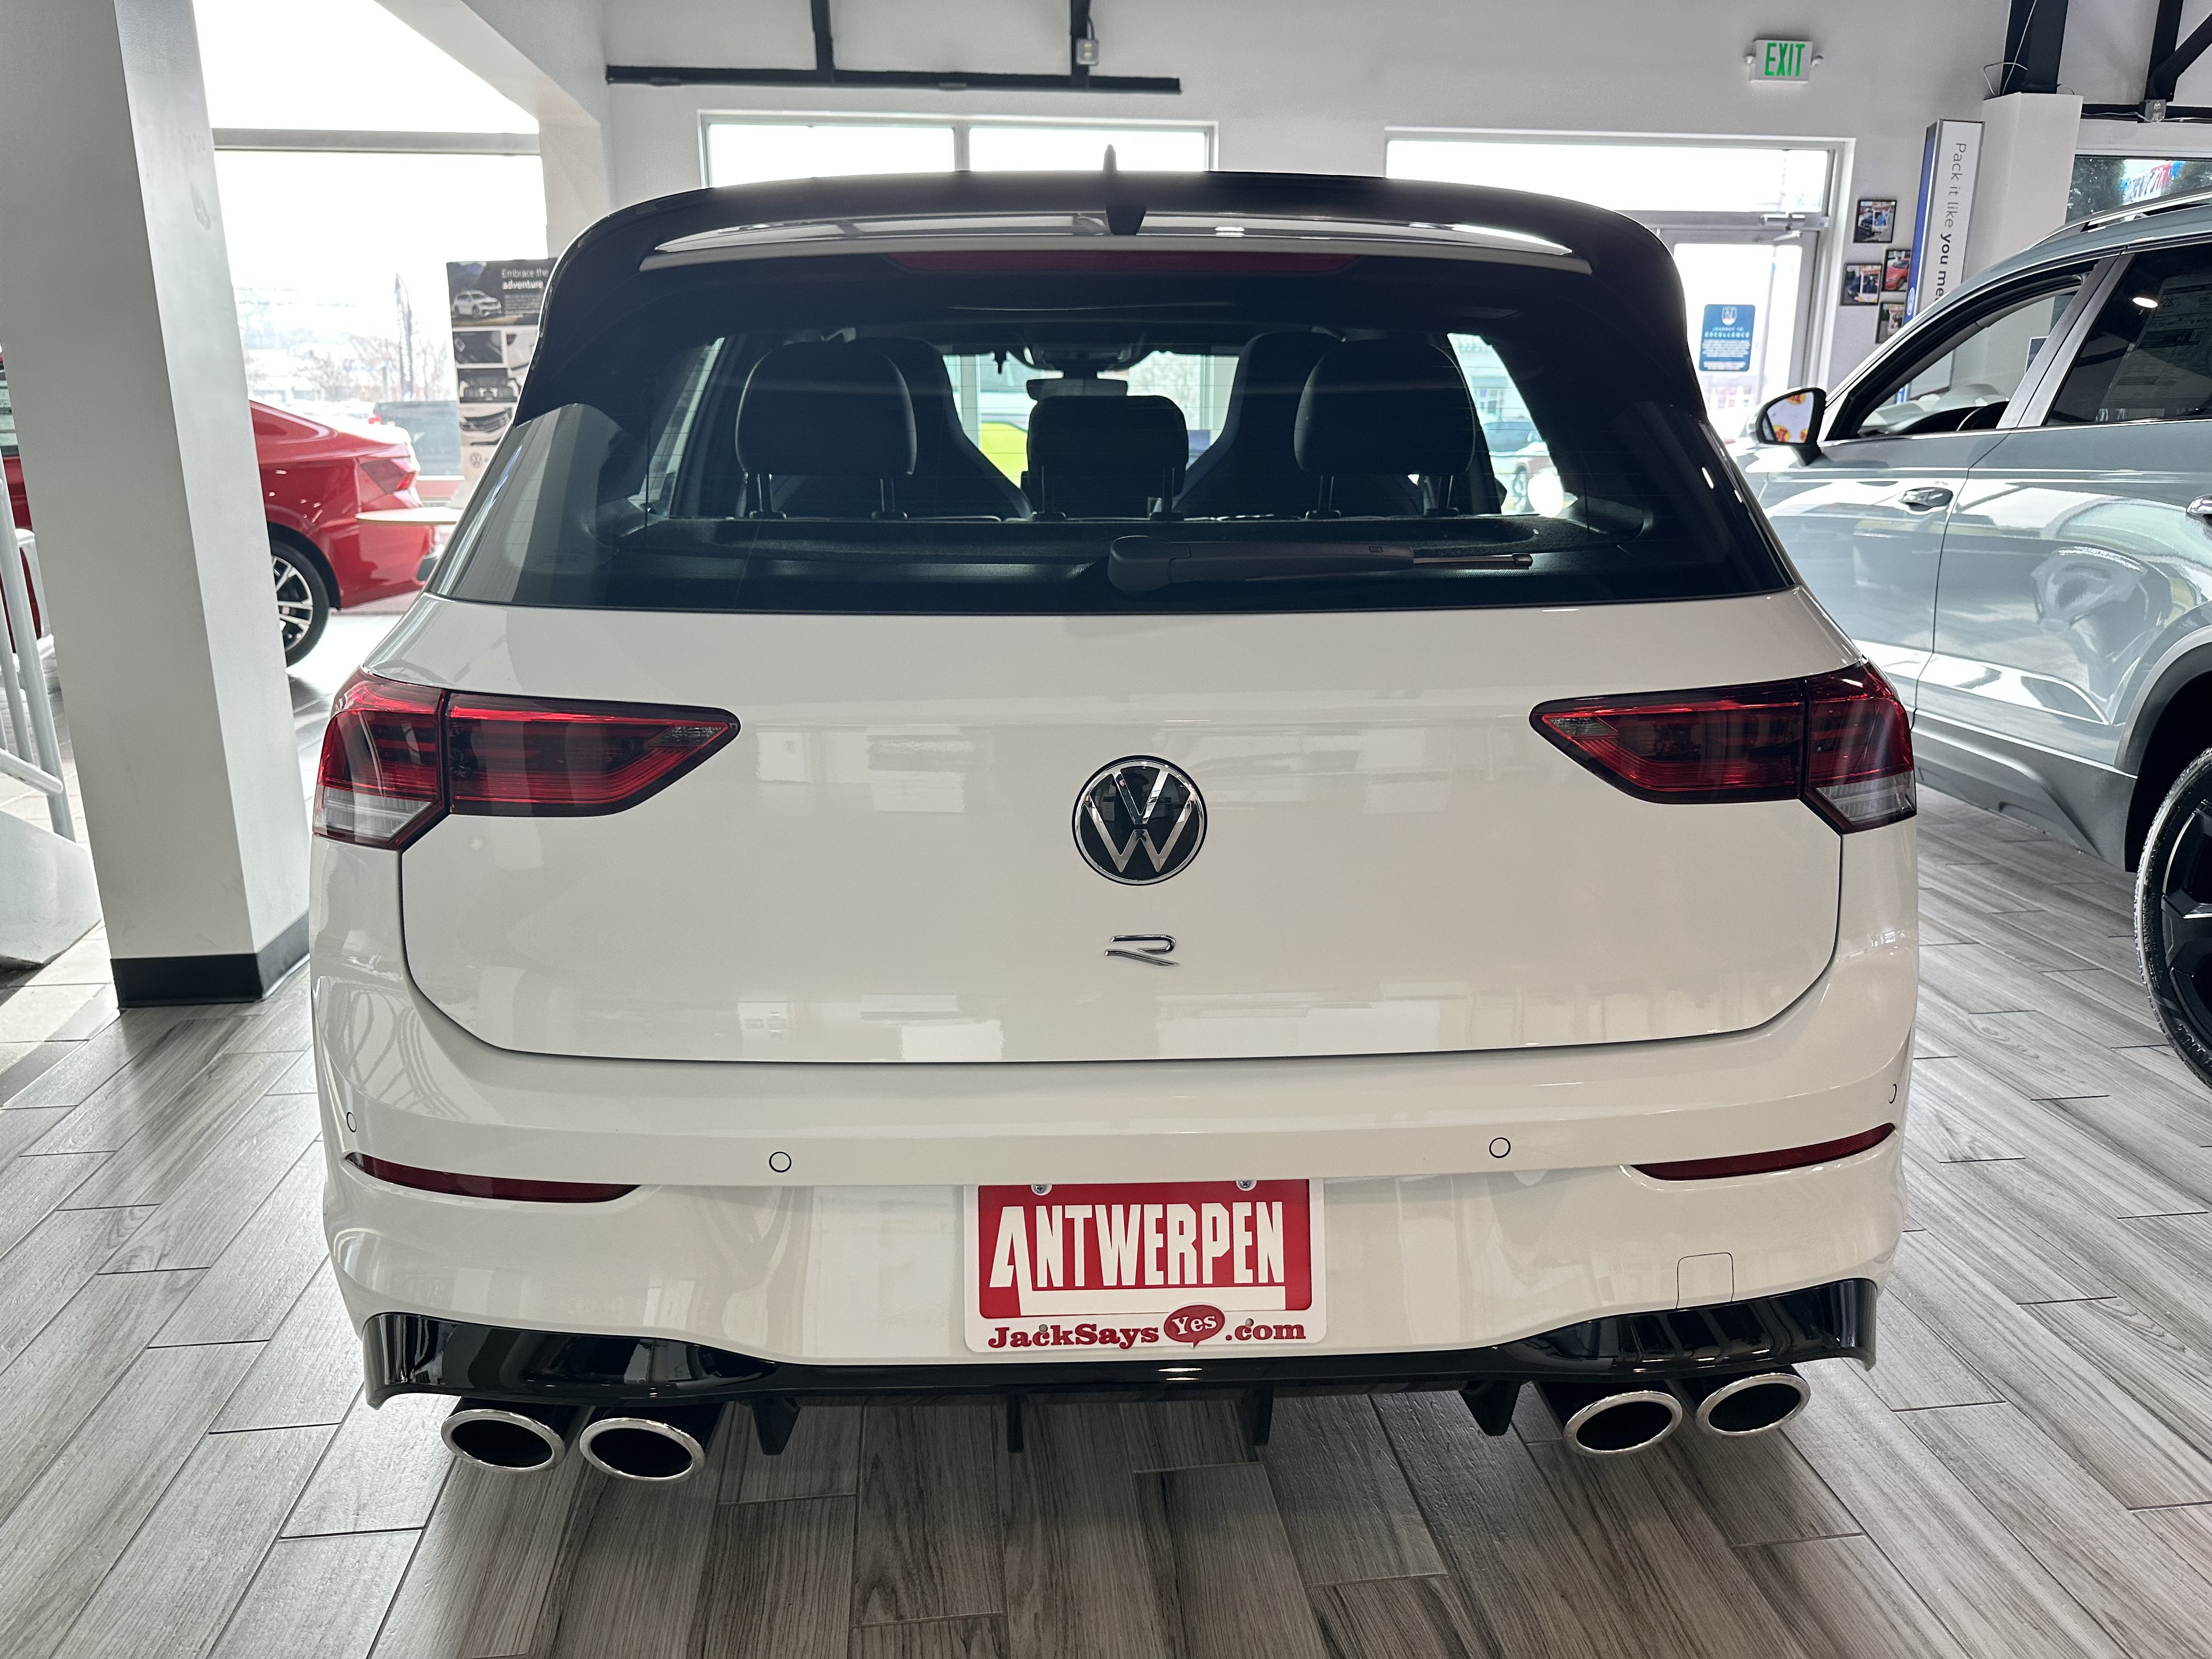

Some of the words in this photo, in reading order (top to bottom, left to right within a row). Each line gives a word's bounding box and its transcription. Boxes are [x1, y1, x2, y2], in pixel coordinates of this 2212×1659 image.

[1764, 42, 1805, 76] EXIT
[1951, 143, 1966, 181] Pack
[1949, 186, 1961, 196] it
[1944, 201, 1959, 228] like
[1940, 233, 1952, 265] you
[501, 279, 544, 290] adventure
[1934, 271, 1946, 301] me
[1104, 934, 1180, 967] R
[989, 1201, 1285, 1316] ANTWERPEN
[1171, 1312, 1217, 1336] Yes
